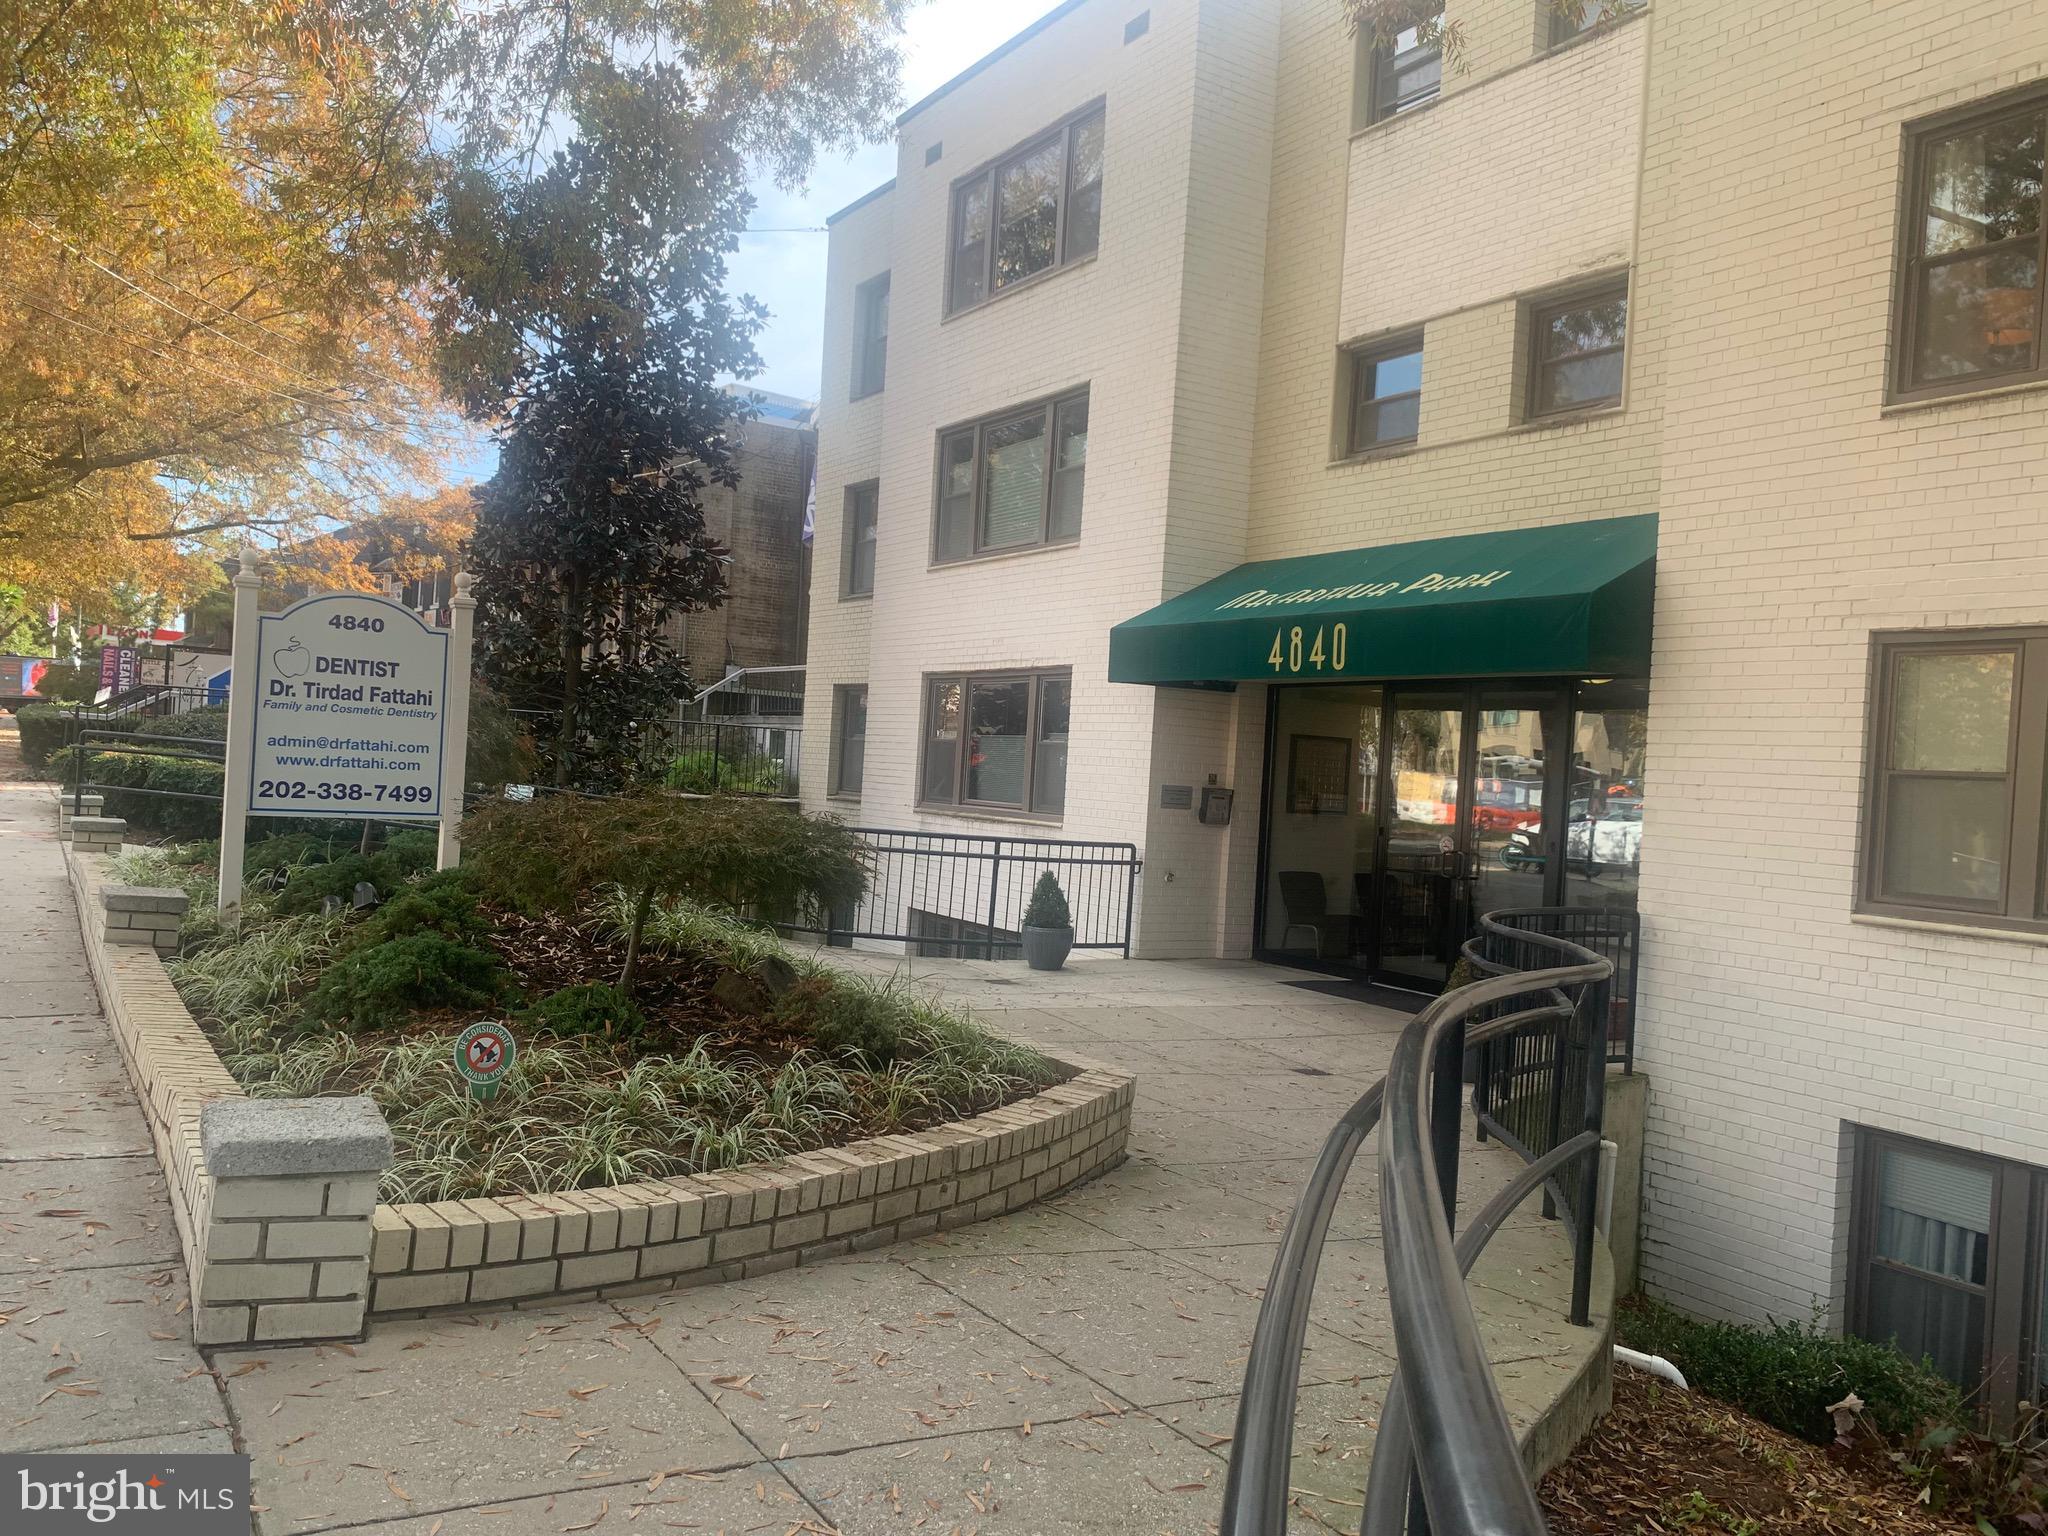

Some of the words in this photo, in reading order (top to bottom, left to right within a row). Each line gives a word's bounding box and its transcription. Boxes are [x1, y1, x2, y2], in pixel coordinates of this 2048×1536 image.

[328, 614, 385, 633] 4840
[1267, 622, 1347, 672] 4840
[102, 648, 115, 677] NAILS
[118, 649, 132, 693] CLEANE
[316, 656, 400, 678] DENTIST
[269, 679, 296, 697] Dr.
[303, 681, 363, 702] Tirdad
[369, 686, 433, 706] Fattahi
[263, 700, 302, 713] Family
[304, 703, 328, 713] and
[330, 703, 384, 716] Cosmetic
[387, 707, 437, 720] Dentistry
[267, 735, 430, 754] admin@drfattahi.com
[275, 754, 421, 771] www.drfattahi.com
[258, 780, 433, 803] 202-338-7499
[459, 1039, 467, 1050] BE
[466, 1025, 512, 1048] CONSIDERATE
[464, 1067, 488, 1080] THANK
[491, 1064, 506, 1078] YOU
